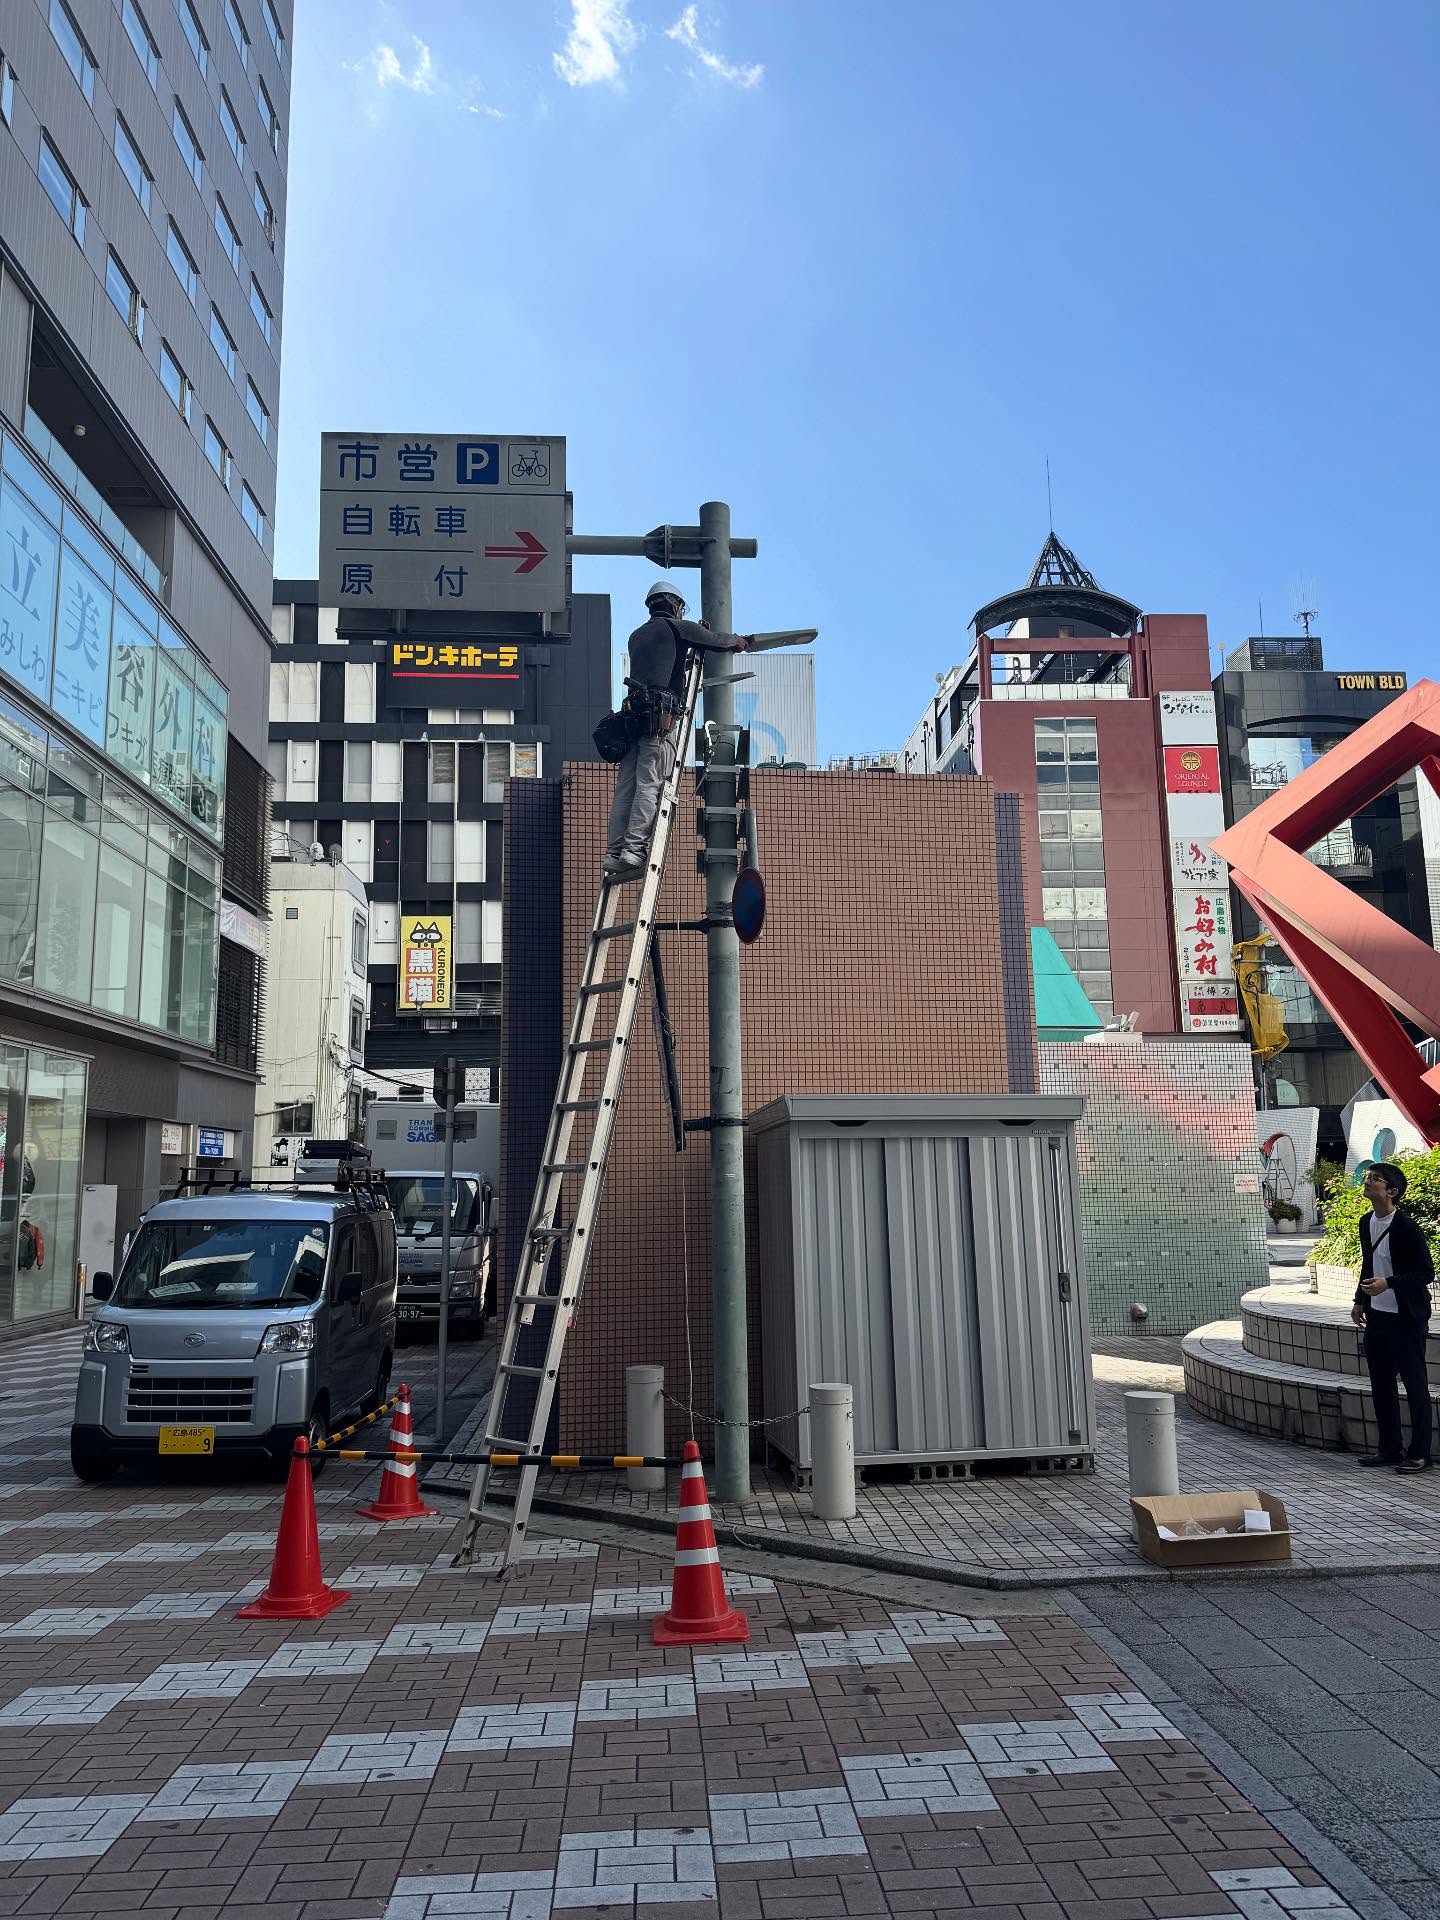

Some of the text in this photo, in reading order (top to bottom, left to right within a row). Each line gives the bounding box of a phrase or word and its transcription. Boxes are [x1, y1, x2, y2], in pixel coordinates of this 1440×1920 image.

[338, 440, 438, 482] 市営
[342, 504, 468, 538] 自転車
[1337, 675, 1404, 689] TOWN BLD
[1174, 773, 1210, 781] ORIENTAL
[1184, 895, 1218, 976] お好み村
[1215, 897, 1226, 935] 広島名物
[408, 949, 434, 1002] 黒猫
[437, 947, 446, 1003] KURONECO
